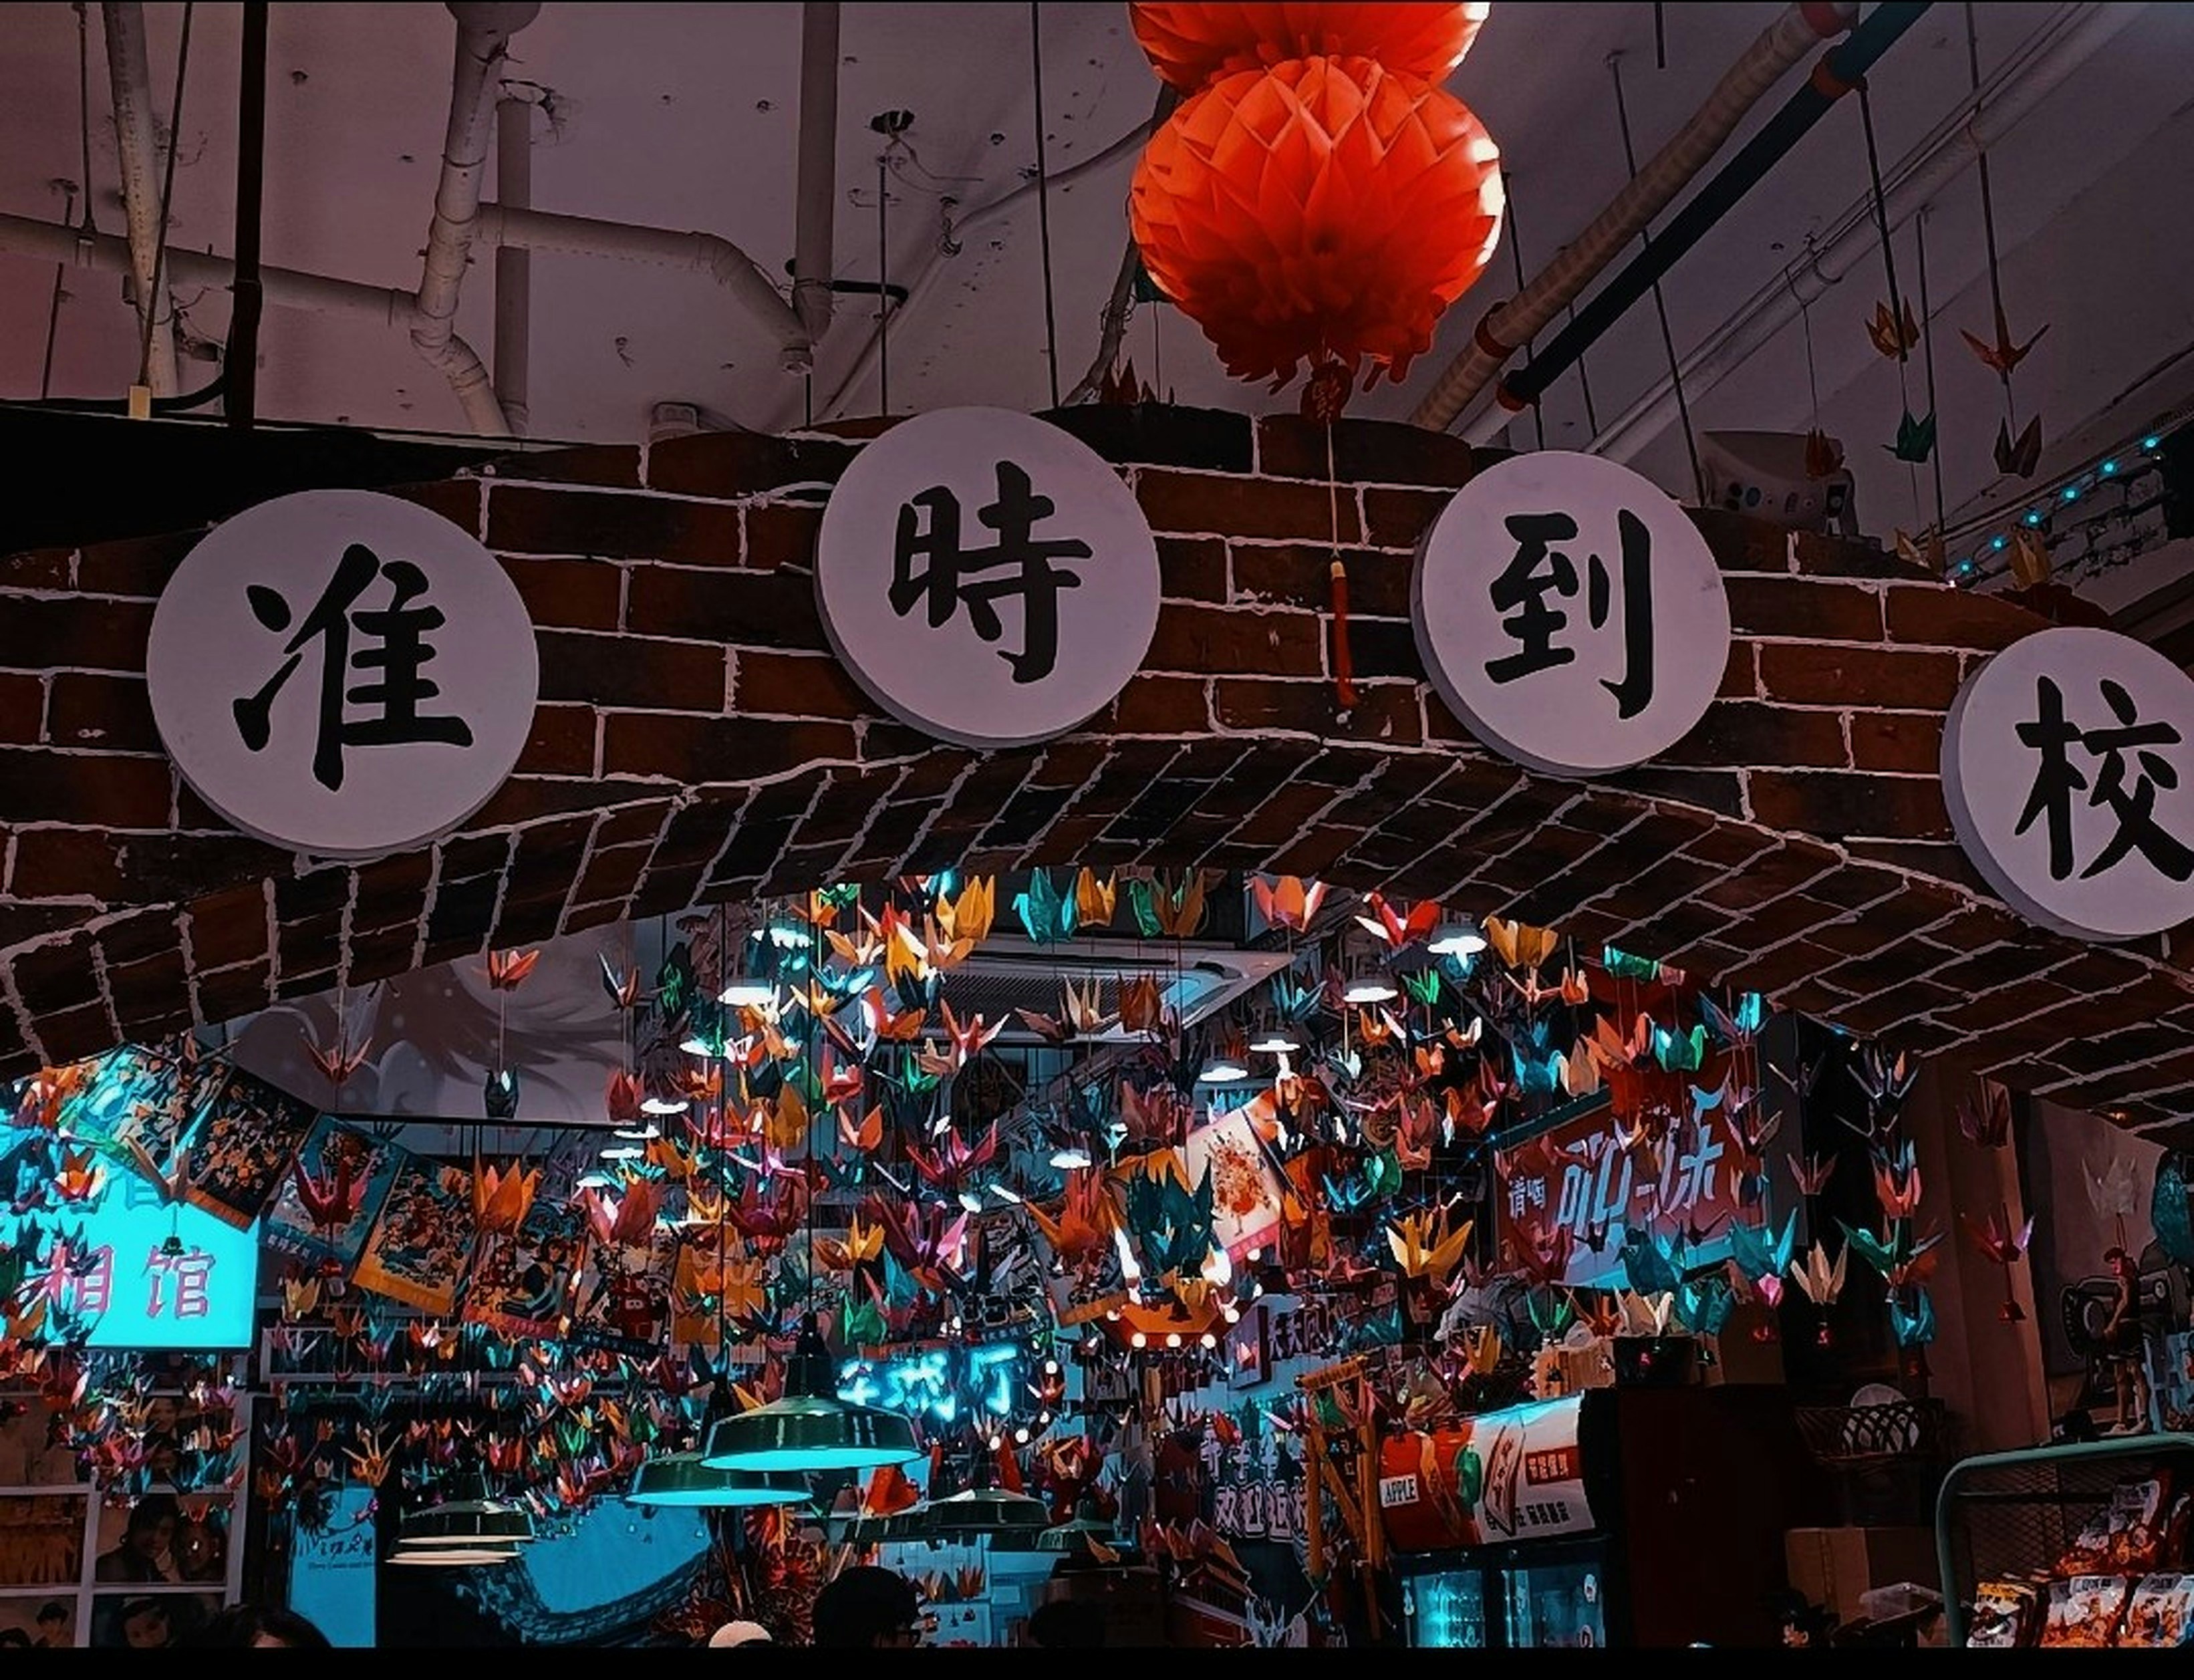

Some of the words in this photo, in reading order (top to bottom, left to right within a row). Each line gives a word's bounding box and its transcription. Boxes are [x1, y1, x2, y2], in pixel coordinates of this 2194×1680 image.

[233, 543, 473, 792] 准
[888, 461, 1093, 684] 時
[1485, 509, 1653, 720] 到
[2014, 676, 2194, 881] 校
[1385, 1478, 1416, 1504] APPLE
